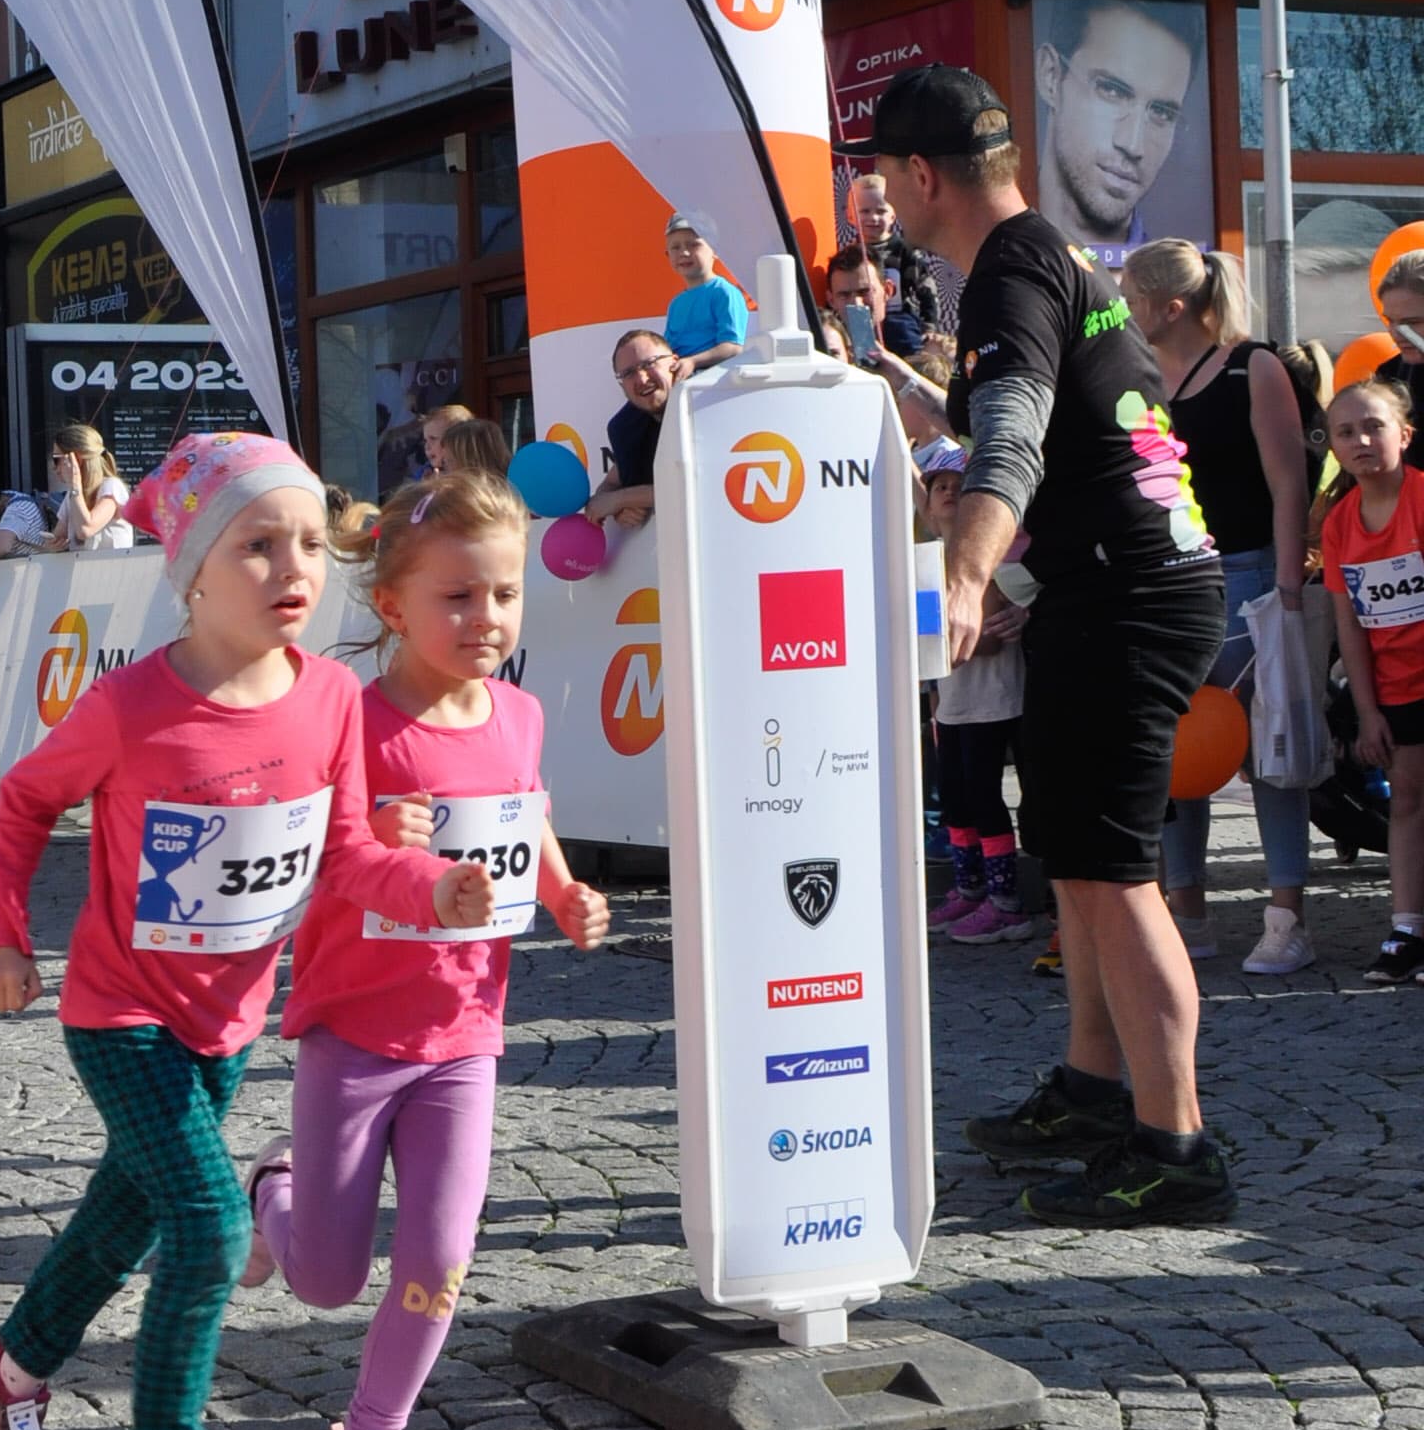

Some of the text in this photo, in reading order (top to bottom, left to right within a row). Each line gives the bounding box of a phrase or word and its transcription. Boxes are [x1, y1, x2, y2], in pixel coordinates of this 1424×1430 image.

[856, 43, 923, 72] OPTIKA
[51, 361, 117, 391] 04
[820, 459, 871, 489] NN
[1367, 575, 1424, 602] 3042
[770, 640, 838, 662] AVON
[831, 749, 870, 762] Powered
[847, 761, 870, 773] MVM
[501, 799, 522, 811] KIDS
[744, 796, 804, 814] innogy
[152, 821, 194, 838] KIDS
[499, 812, 519, 823] CUP
[152, 838, 189, 854] CUP
[217, 842, 313, 898] 3231
[773, 977, 859, 1003] NUTREND
[801, 1127, 872, 1155] ŠKODA
[783, 1214, 863, 1247] KPMG
